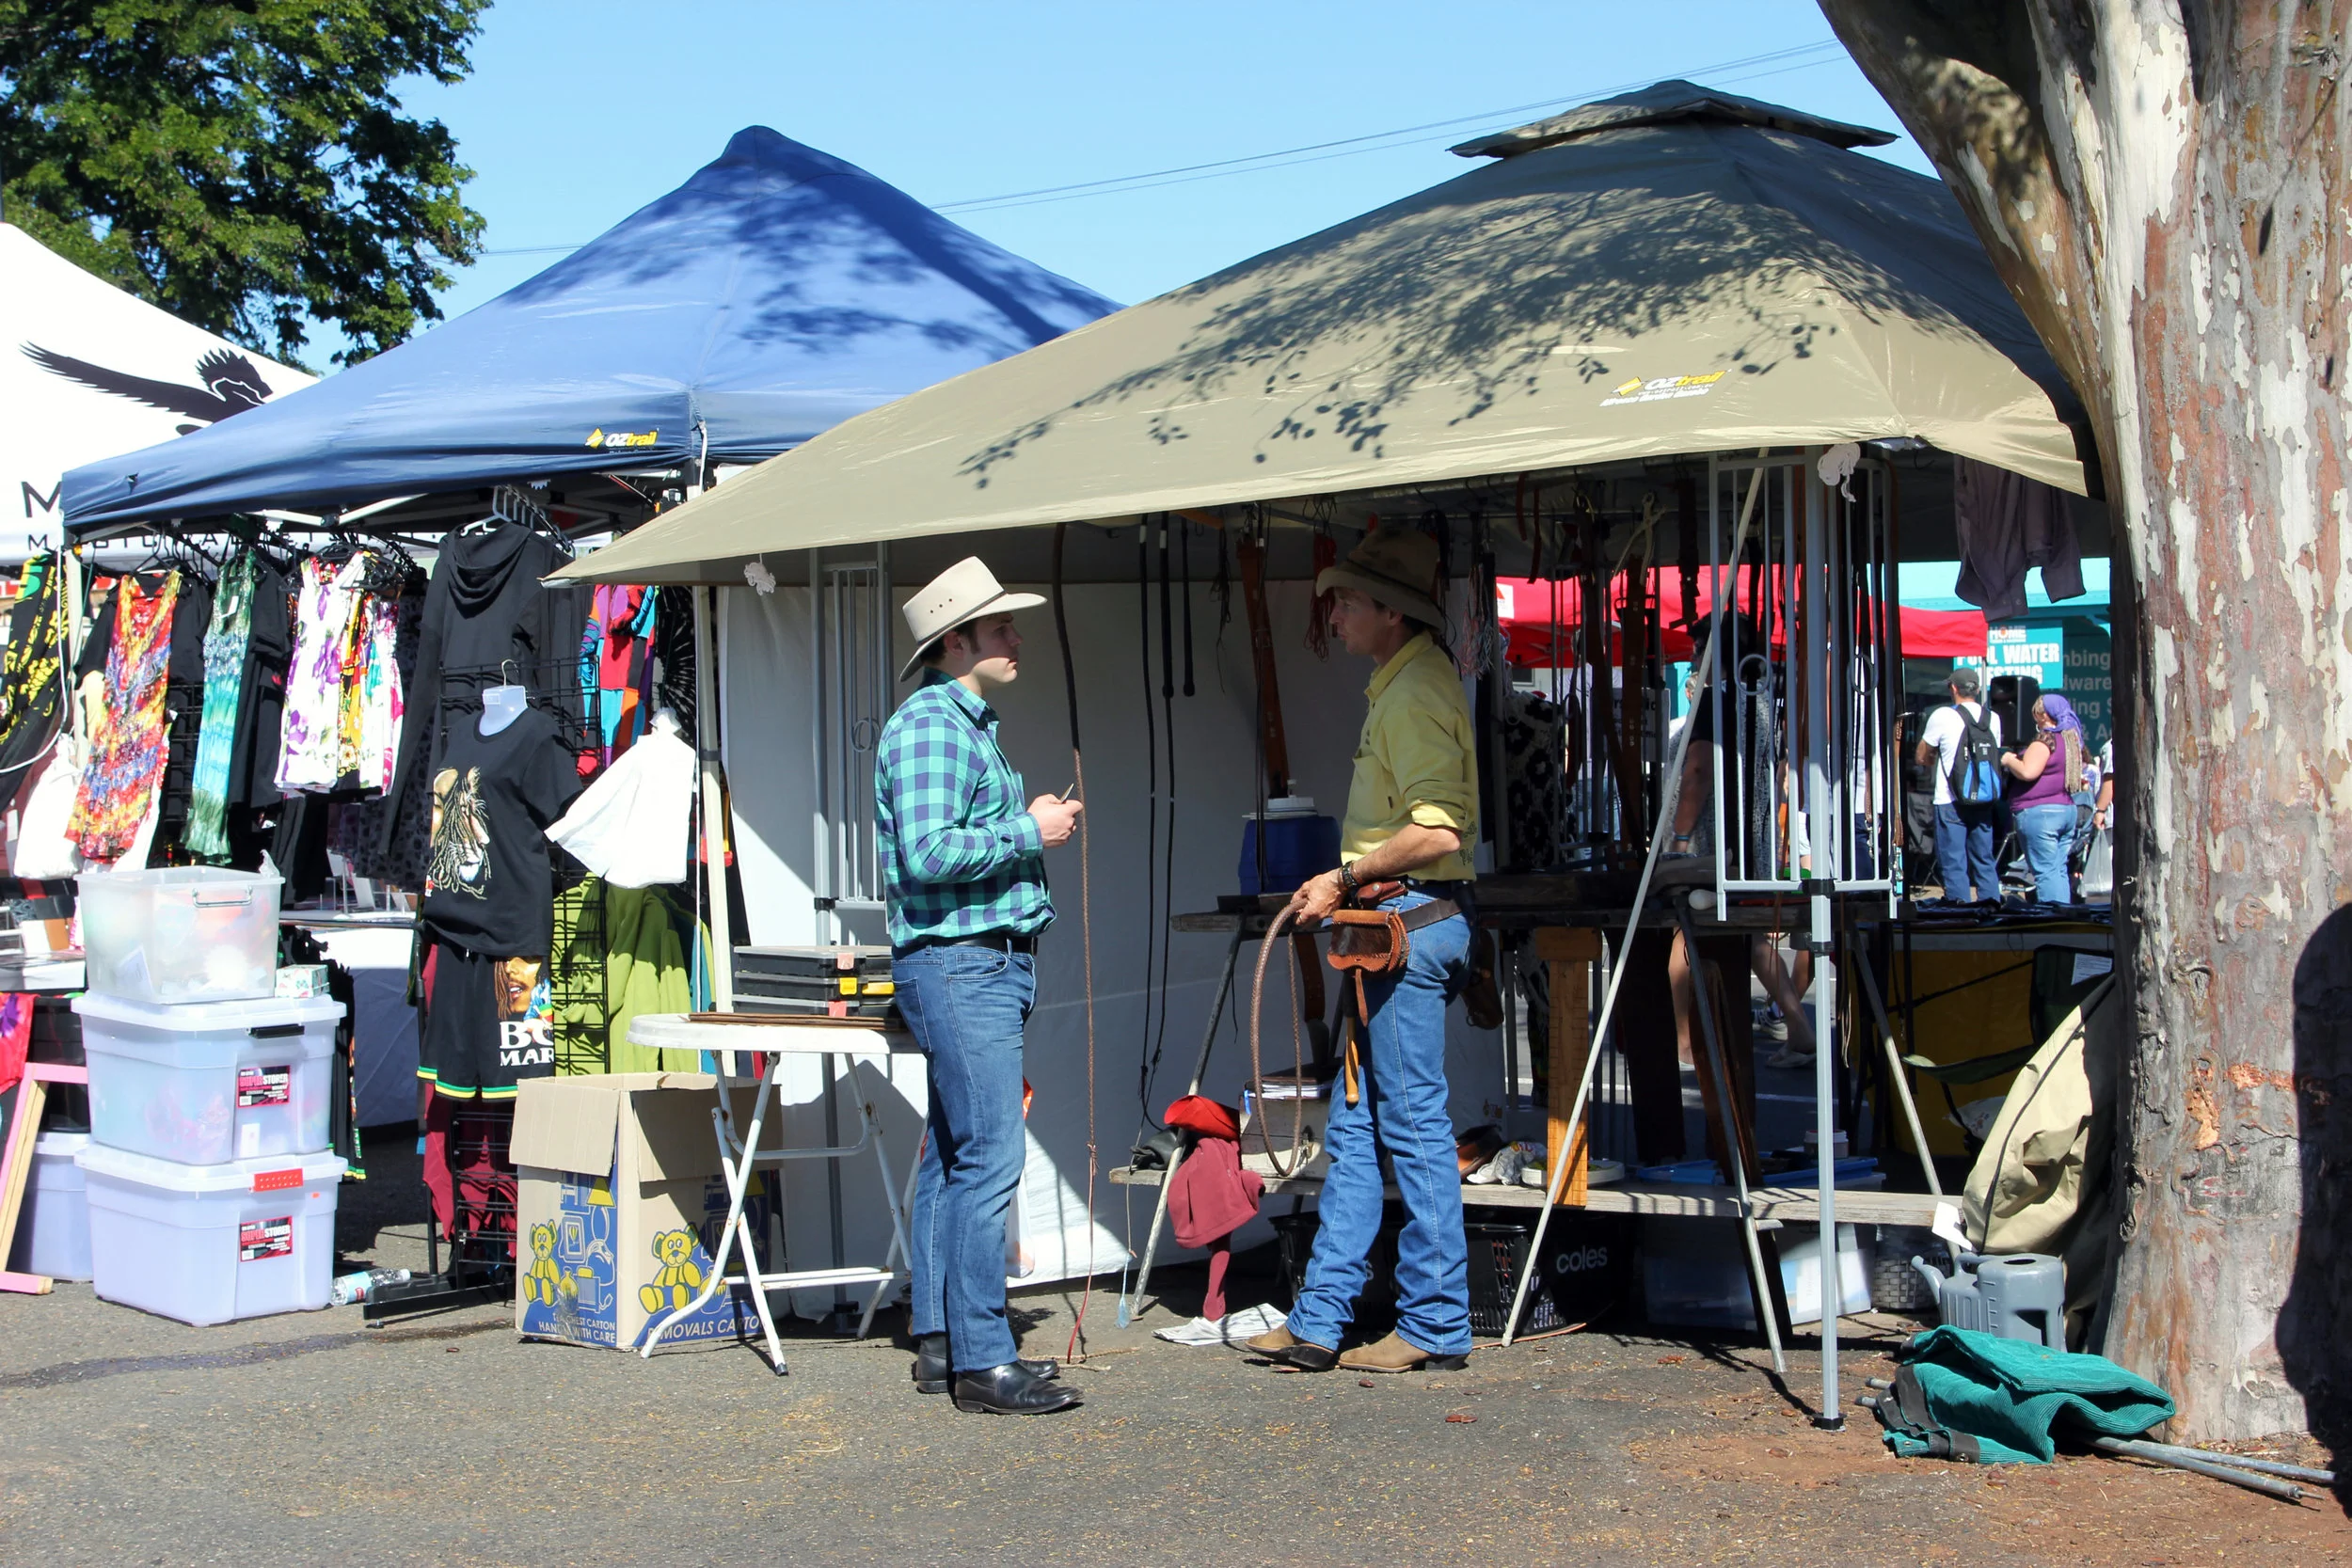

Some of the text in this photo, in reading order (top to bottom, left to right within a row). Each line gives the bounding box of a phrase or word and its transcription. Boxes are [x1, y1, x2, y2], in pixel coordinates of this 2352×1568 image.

[2003, 642, 2060, 665] WATER
[1556, 1244, 1608, 1274] coles
[586, 1318, 615, 1331] CARTON
[717, 1315, 761, 1334] CARTO
[572, 1326, 593, 1339] WITH
[593, 1330, 616, 1343] CARE
